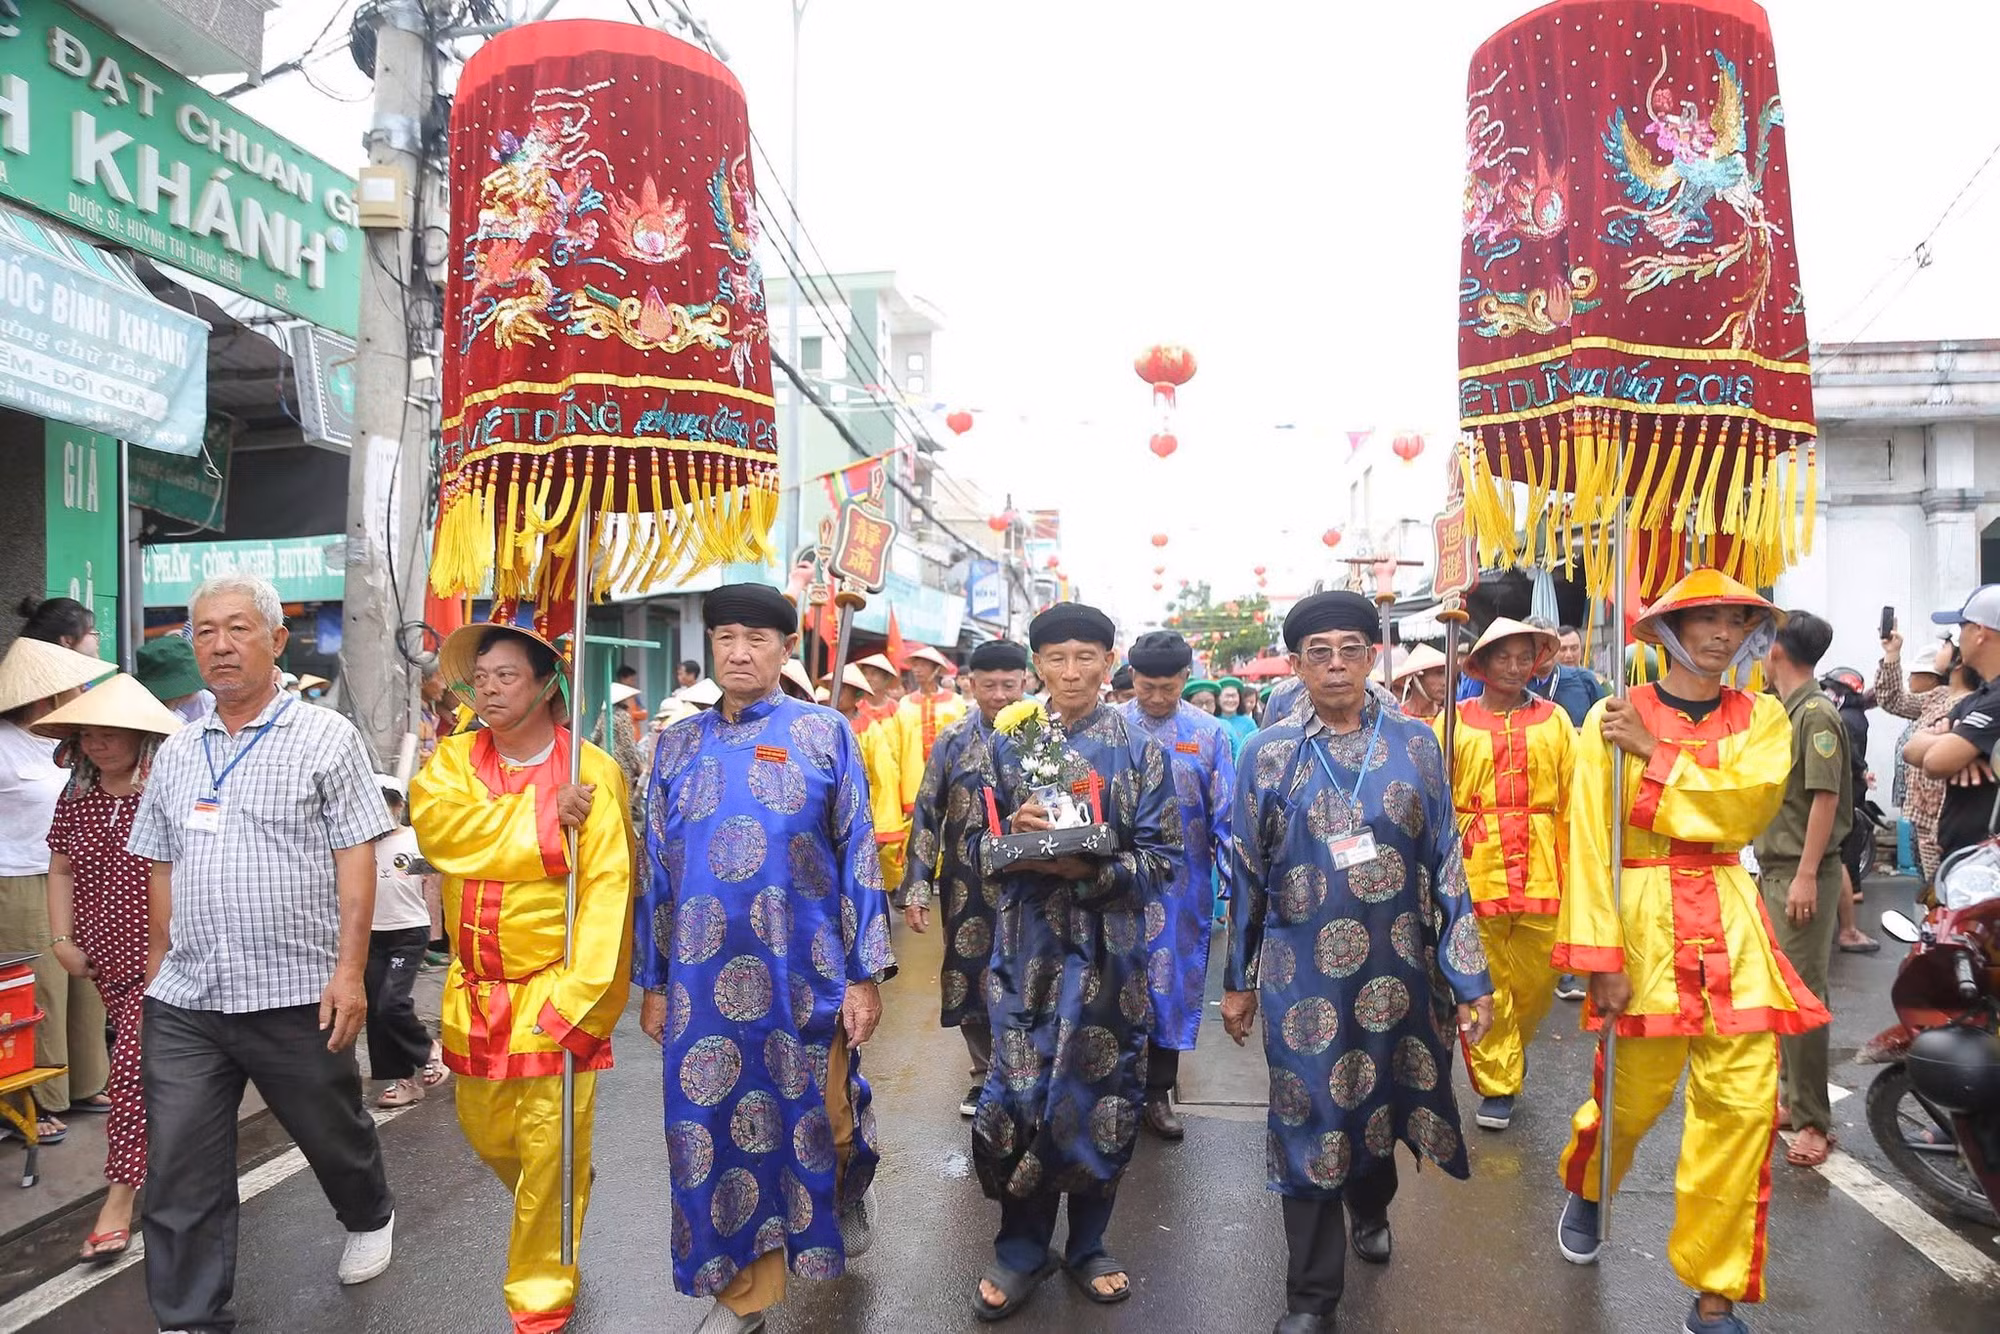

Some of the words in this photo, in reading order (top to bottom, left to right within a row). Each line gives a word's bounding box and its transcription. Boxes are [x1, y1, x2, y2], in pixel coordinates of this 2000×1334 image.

[48, 25, 163, 118] ĐẠT
[71, 109, 326, 290] KHÁNH
[127, 217, 166, 250] HUỲNH
[168, 236, 187, 265] THỊ
[51, 277, 111, 342] BÌNH
[118, 313, 189, 370] KHÁNH
[1676, 372, 1754, 409] 2018
[63, 436, 99, 513] GIÁ
